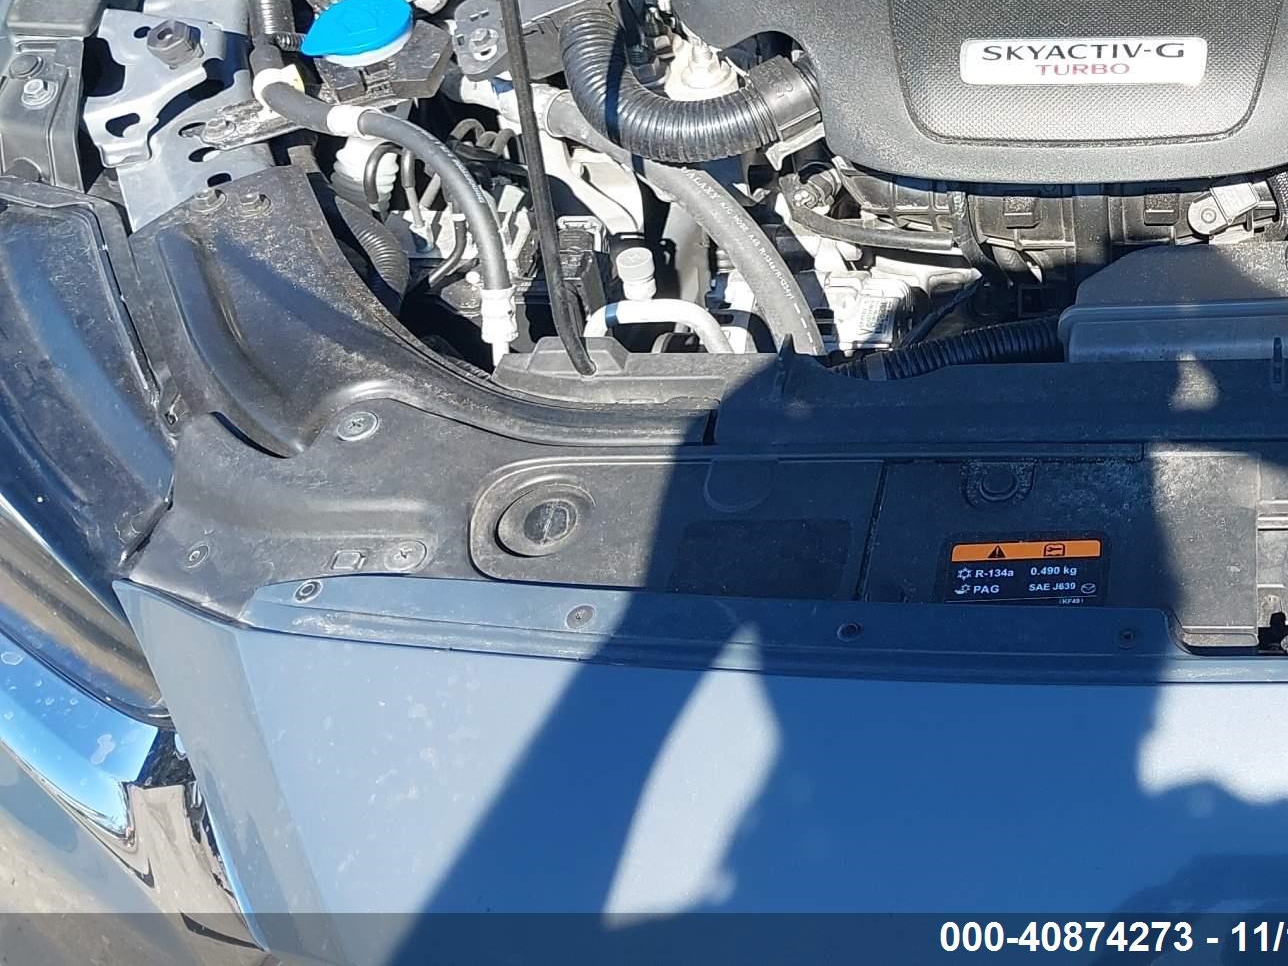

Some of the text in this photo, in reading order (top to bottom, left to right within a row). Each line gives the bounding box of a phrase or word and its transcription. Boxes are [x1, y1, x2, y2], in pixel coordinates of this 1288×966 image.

[981, 42, 1185, 62] SKYACTIV-G
[1035, 63, 1131, 76] TURBO
[974, 568, 1014, 578] R-134a
[1030, 565, 1077, 576] 0.490 kg
[973, 584, 1000, 595] PAG
[1028, 582, 1076, 592] SAE J639
